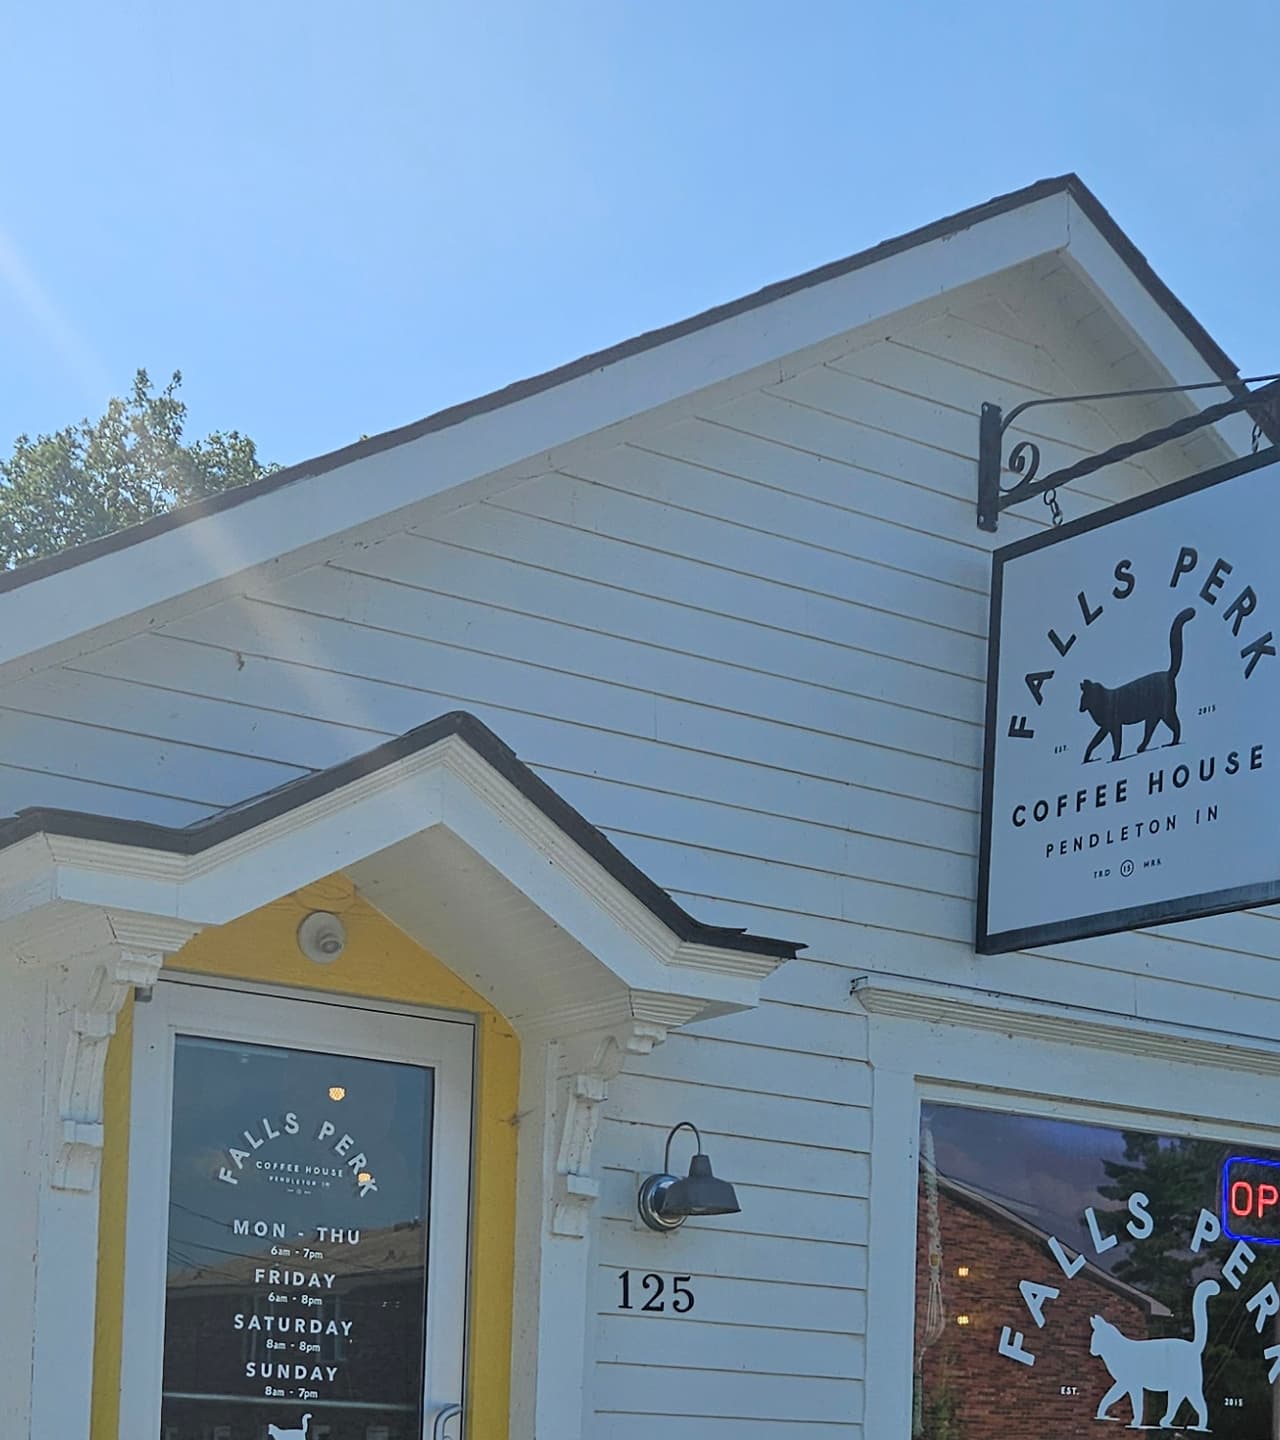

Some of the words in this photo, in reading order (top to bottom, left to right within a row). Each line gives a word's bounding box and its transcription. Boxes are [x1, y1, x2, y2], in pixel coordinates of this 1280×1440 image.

[1007, 560, 1135, 739] FALLS
[1169, 546, 1277, 679] PERK
[1012, 779, 1128, 827] COFFEE
[1148, 744, 1265, 795] HOUSE
[1046, 814, 1177, 858] PENDLETON
[1195, 805, 1218, 824] IN
[218, 1112, 300, 1185] FALLS
[318, 1120, 378, 1198] PERK
[256, 1160, 300, 1173] COFFEE
[305, 1166, 343, 1178] HOUSE
[233, 1219, 286, 1238] MON
[317, 1227, 360, 1245] THU
[270, 1246, 291, 1257] 6am
[303, 1248, 324, 1260] 7pm
[255, 1268, 336, 1289] FRIDAY
[998, 1192, 1154, 1366] FALLS
[268, 1292, 288, 1303] 6am
[301, 1294, 323, 1306] 8pm
[617, 1270, 695, 1313] 125
[234, 1313, 353, 1336] SATURDAY
[266, 1339, 286, 1350] 8am
[299, 1341, 321, 1353] 8pm
[245, 1362, 338, 1381] SUNDAY
[265, 1386, 285, 1397] 8am
[298, 1388, 318, 1400] 7pm
[1060, 1386, 1080, 1396] EST.
